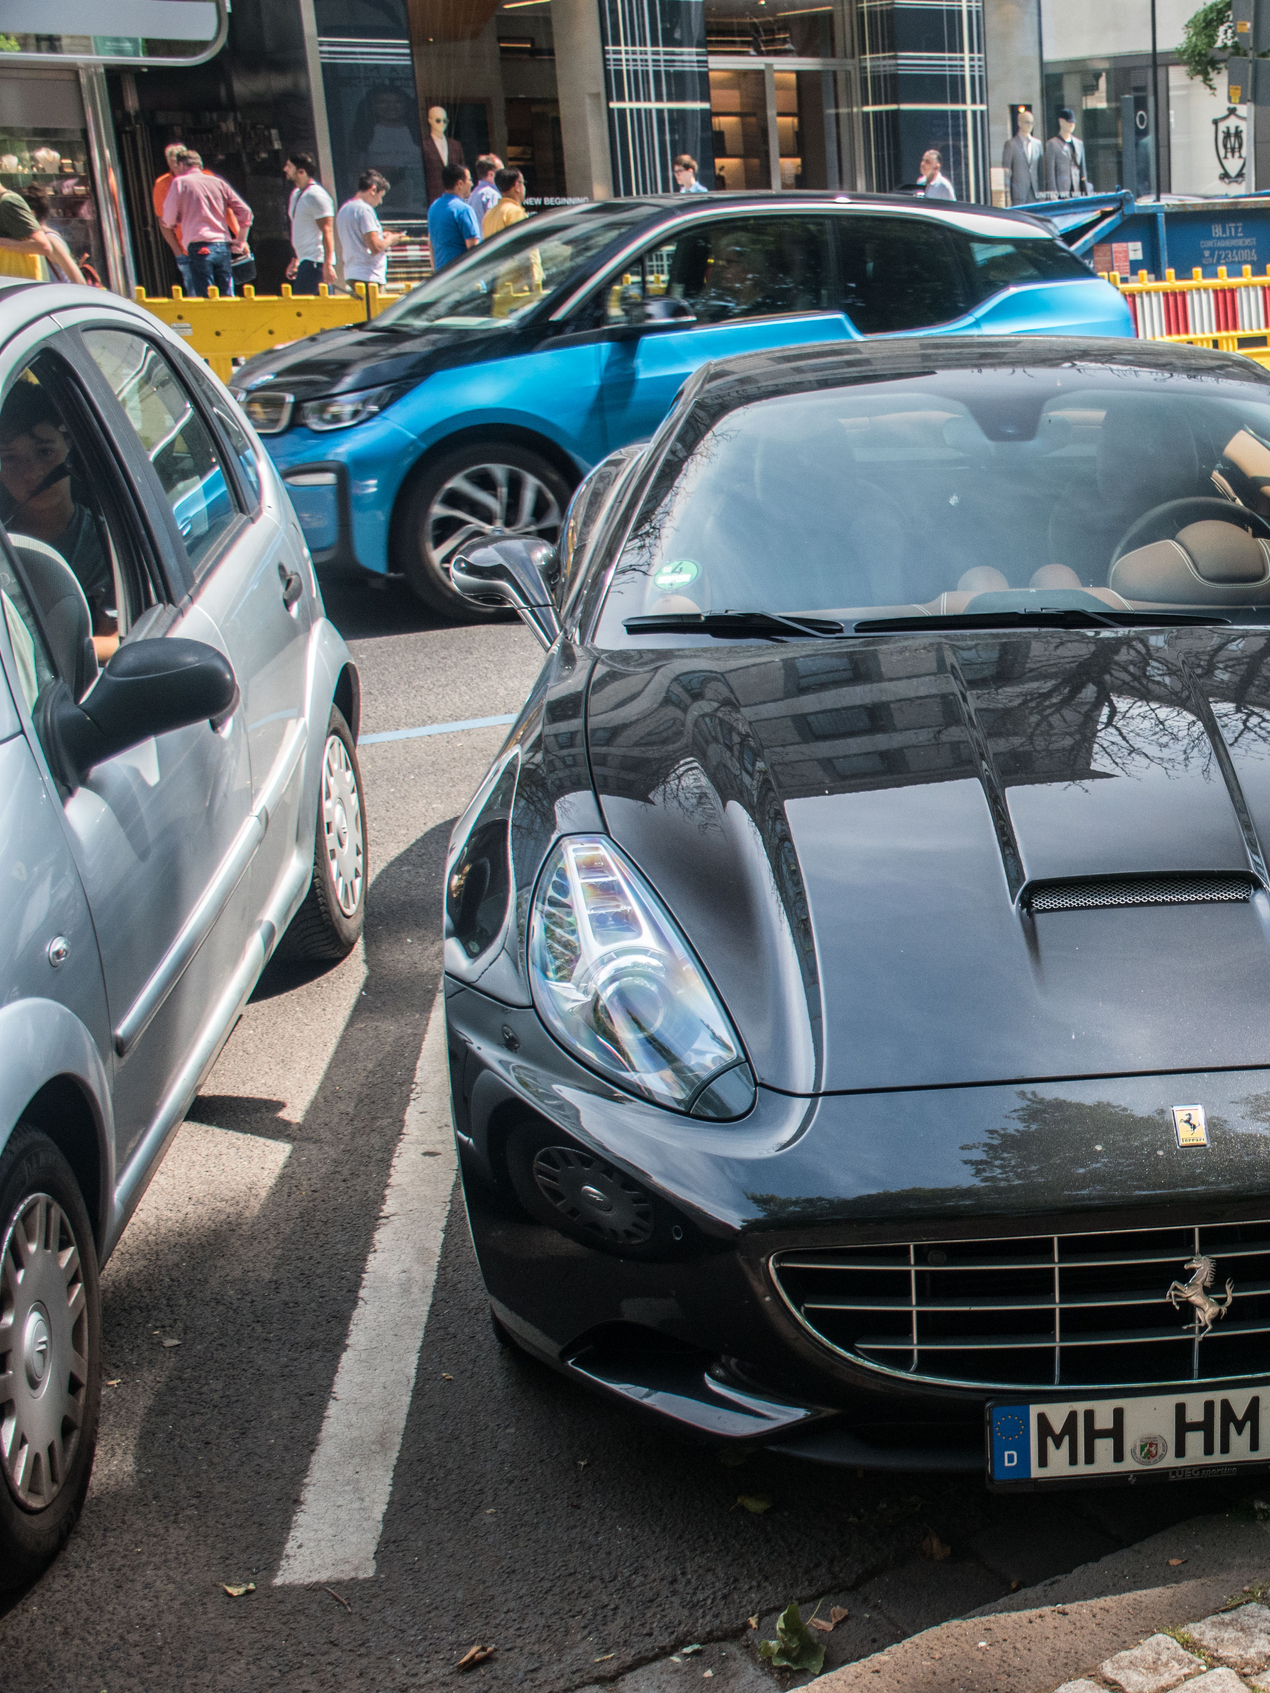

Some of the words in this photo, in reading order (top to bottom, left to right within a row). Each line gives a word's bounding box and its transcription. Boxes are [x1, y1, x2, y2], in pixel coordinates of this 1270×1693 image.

[522, 197, 543, 206] NEW
[1211, 223, 1243, 238] BLITZ
[1037, 1407, 1125, 1468] MH
[1175, 1396, 1260, 1459] HM
[1004, 1450, 1018, 1467] D
